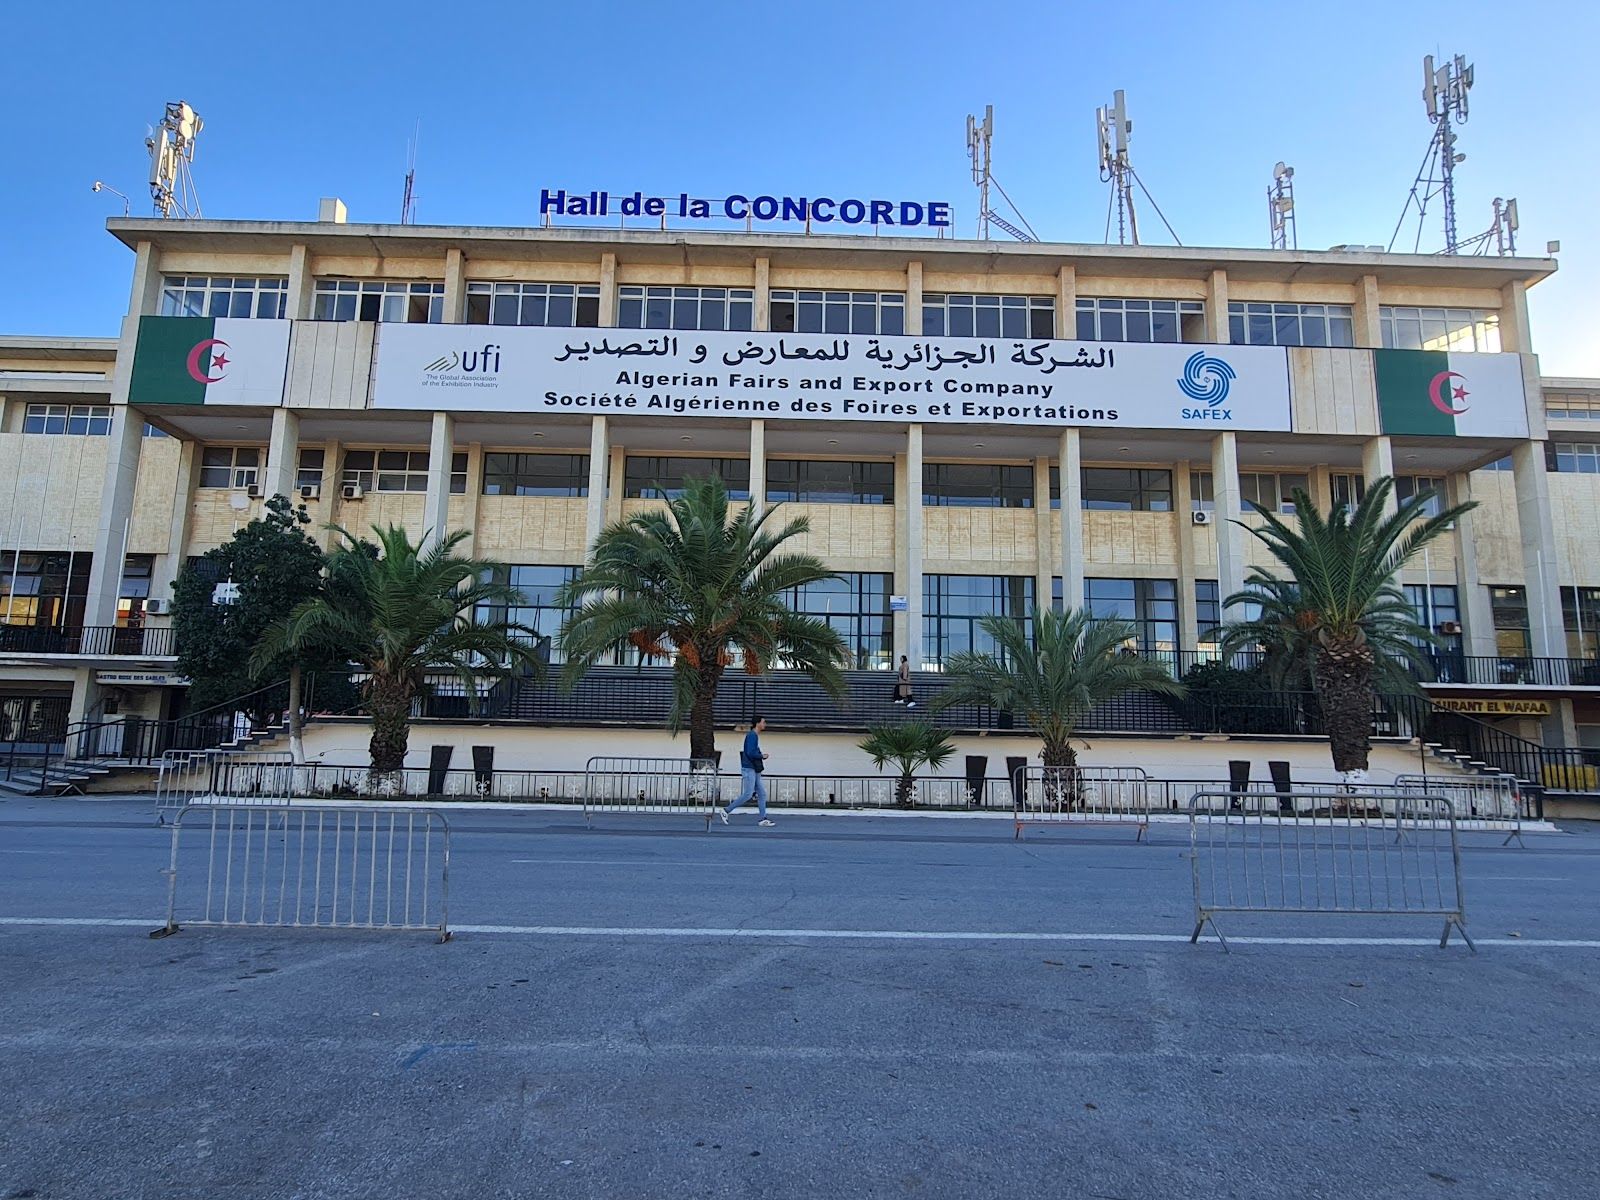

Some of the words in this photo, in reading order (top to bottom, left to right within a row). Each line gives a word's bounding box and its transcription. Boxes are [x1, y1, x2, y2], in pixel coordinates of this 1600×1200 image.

[540, 189, 608, 216] Hall
[620, 191, 665, 216] de
[679, 193, 710, 218] la
[724, 194, 949, 227] CONCORDE
[462, 344, 501, 373] ufi
[554, 335, 678, 362] التصدير
[688, 344, 707, 364] و
[722, 338, 850, 367] للمعارض
[865, 339, 995, 372] الجزائرية
[1010, 342, 1114, 375] الشركة
[461, 374, 497, 382] Association
[473, 381, 499, 389] Industry
[615, 370, 718, 389] Algerian
[729, 372, 789, 389] Fairs
[799, 376, 842, 390] and
[853, 376, 933, 395] Export
[943, 379, 1053, 399] Company
[543, 391, 637, 408] Société
[647, 393, 780, 413] Algérienne
[790, 398, 832, 413] des
[843, 399, 918, 415] Foires
[927, 402, 951, 416] et
[962, 401, 1119, 421] Exportations
[1181, 408, 1232, 420] SAFEX
[1487, 702, 1501, 712] EL
[1503, 702, 1548, 713] WAFAA
